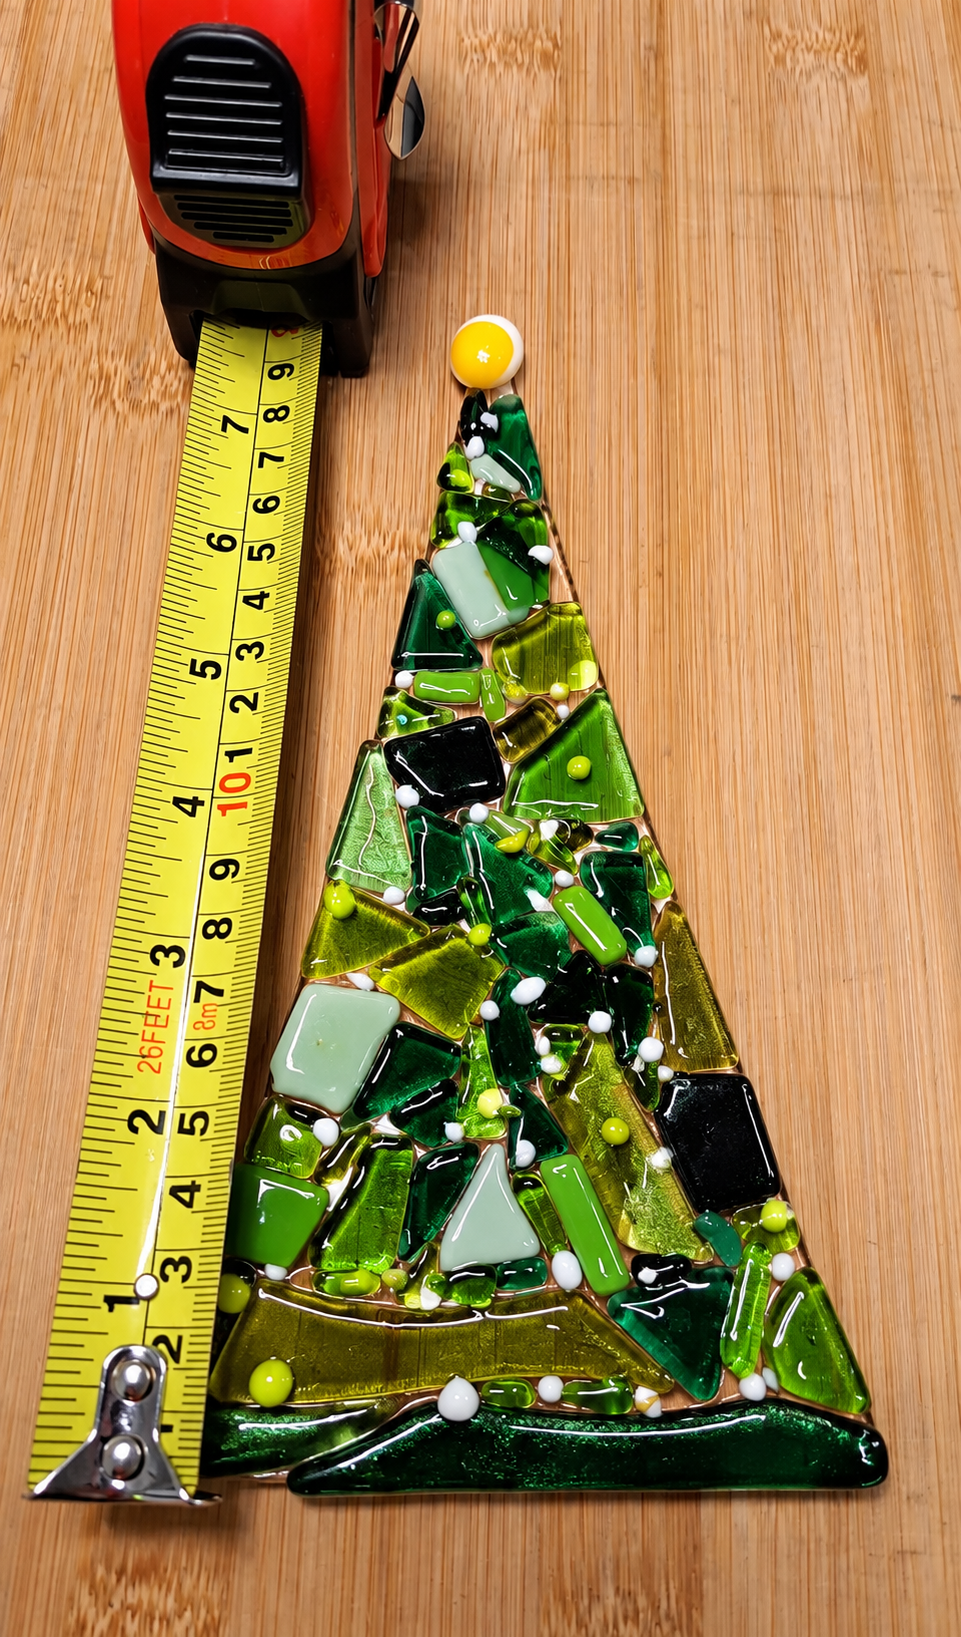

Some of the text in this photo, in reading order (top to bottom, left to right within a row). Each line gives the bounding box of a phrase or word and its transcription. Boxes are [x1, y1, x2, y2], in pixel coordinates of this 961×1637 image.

[268, 363, 294, 380] 9
[263, 405, 290, 423] 8
[221, 415, 249, 434] 7
[258, 452, 284, 468] 7
[253, 496, 280, 514] 6
[207, 533, 237, 552] 6
[247, 544, 275, 561] 5
[243, 591, 269, 610] 4
[236, 642, 264, 661] 3
[189, 659, 221, 679] 5
[230, 692, 258, 713] 2
[225, 748, 252, 762] 1
[217, 773, 251, 817] 10
[172, 797, 204, 817] 4
[209, 859, 239, 880] 9
[202, 918, 232, 939] 8
[150, 945, 185, 968] 3
[194, 981, 224, 1003] 7
[186, 1044, 217, 1067] 6
[127, 1110, 165, 1135] 2
[178, 1111, 209, 1136] 5
[169, 1181, 201, 1208] 4
[160, 1256, 192, 1283] 3
[104, 1295, 140, 1312] 1
[152, 1335, 182, 1364] 2
